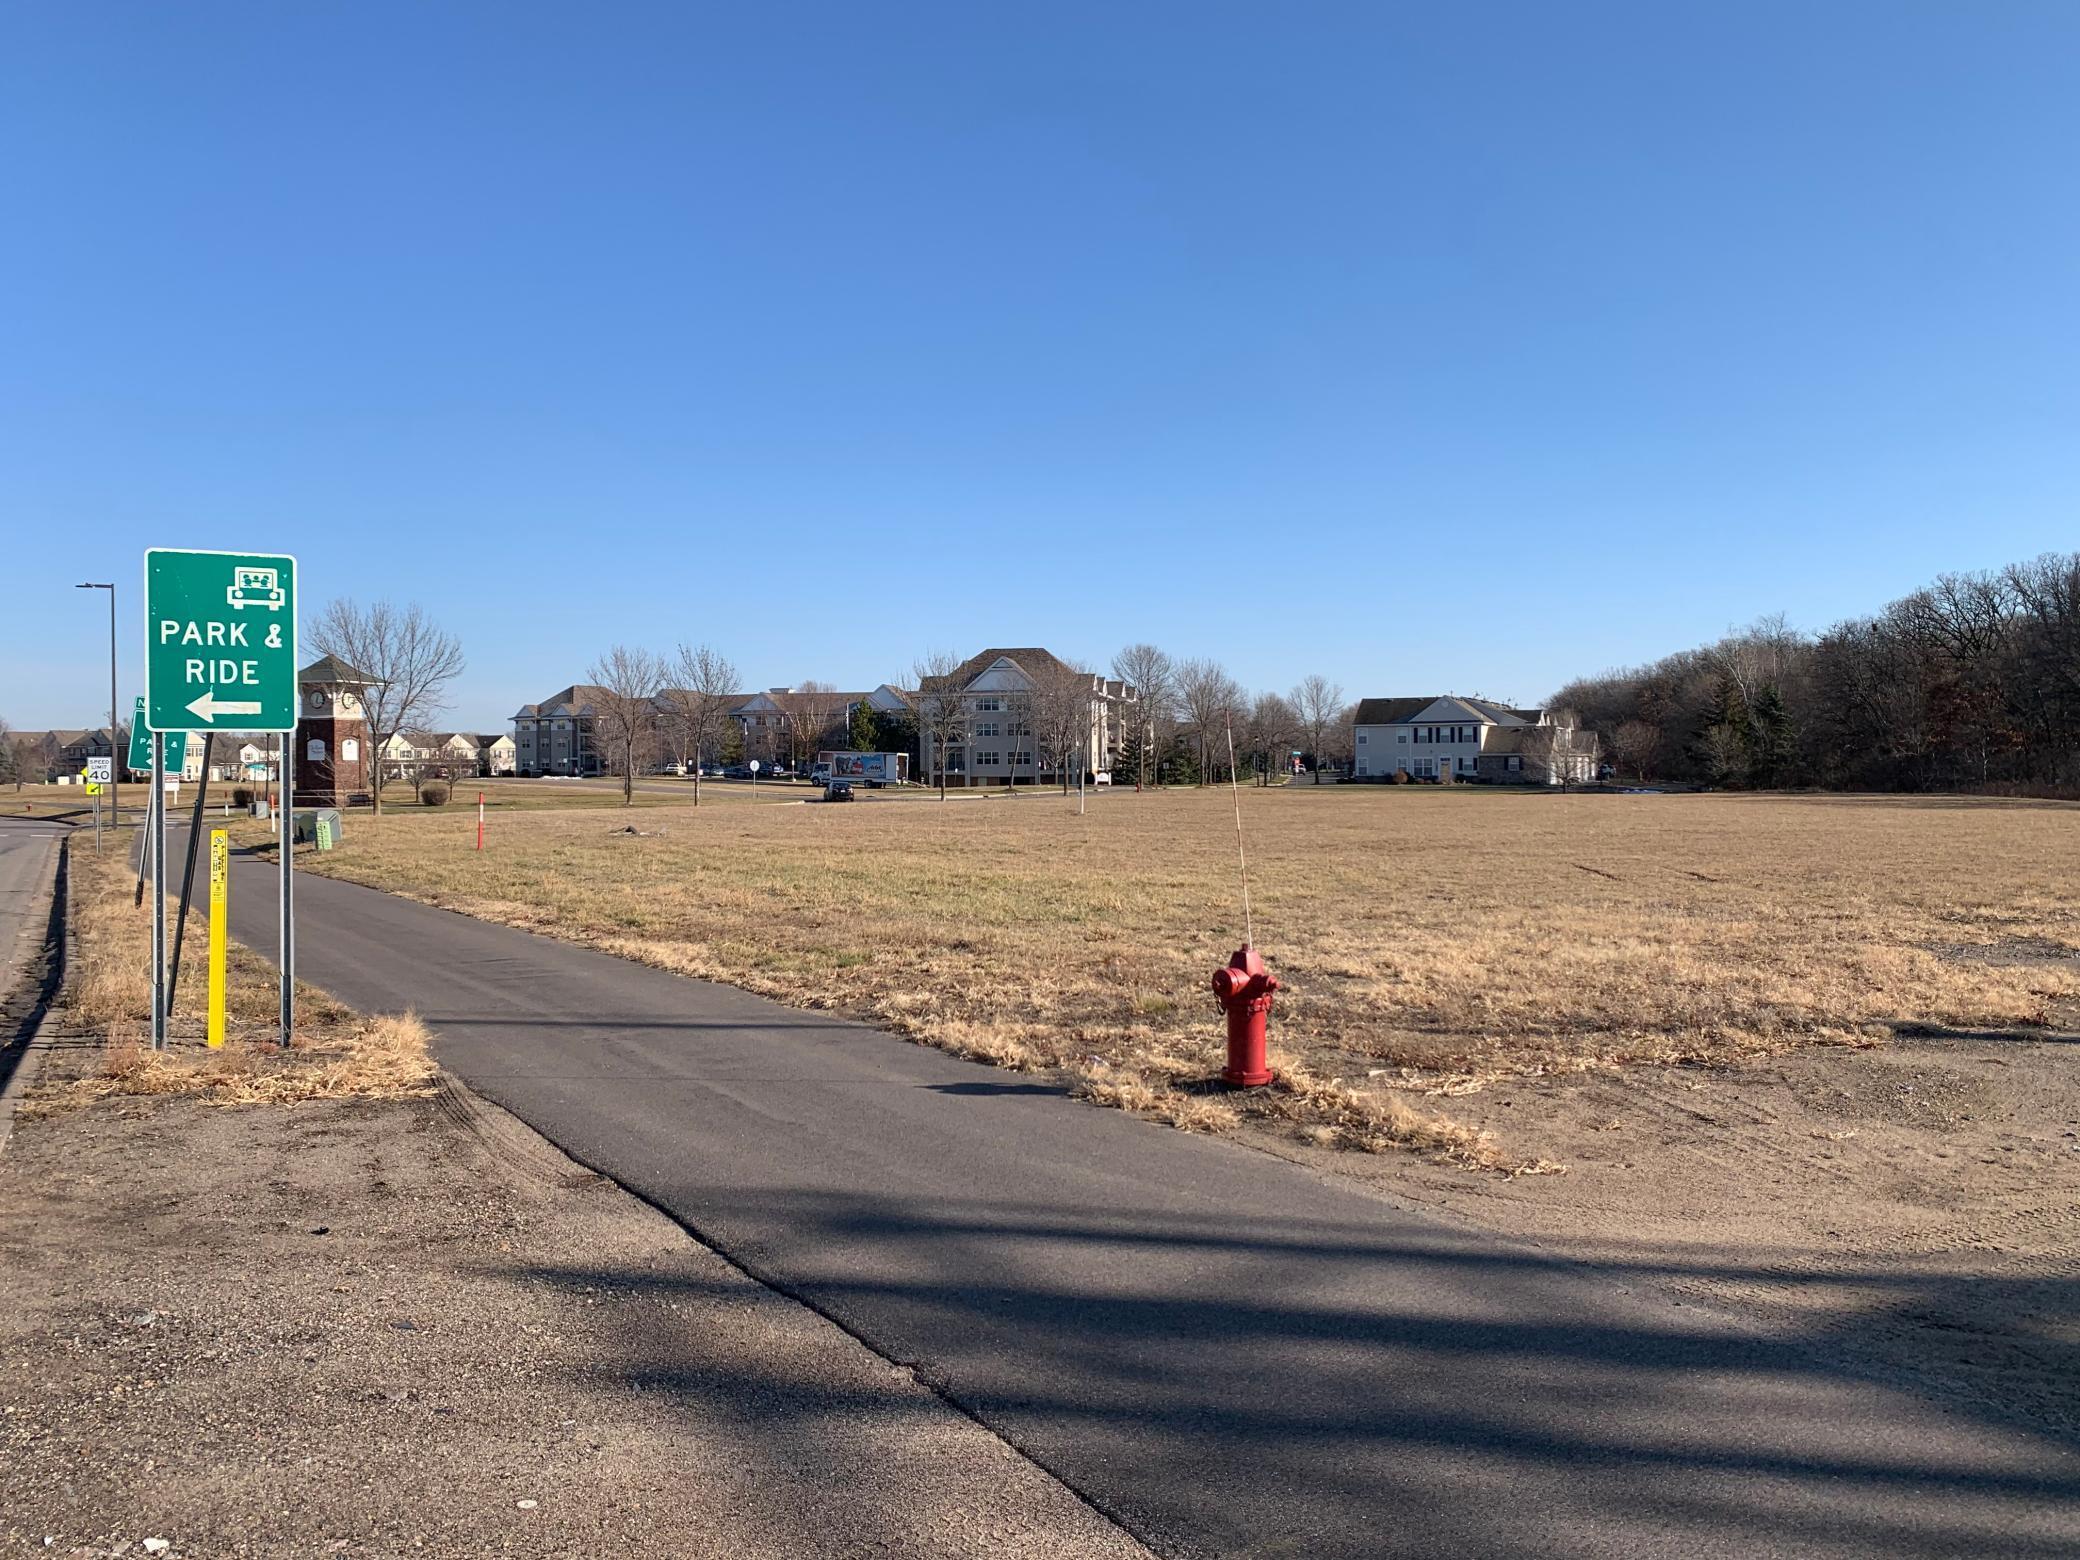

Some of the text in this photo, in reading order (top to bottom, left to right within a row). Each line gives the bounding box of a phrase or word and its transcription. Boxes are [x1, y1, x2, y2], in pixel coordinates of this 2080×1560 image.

[161, 620, 283, 648] PARK &
[186, 659, 260, 685] RIDE
[89, 770, 110, 780] 40
